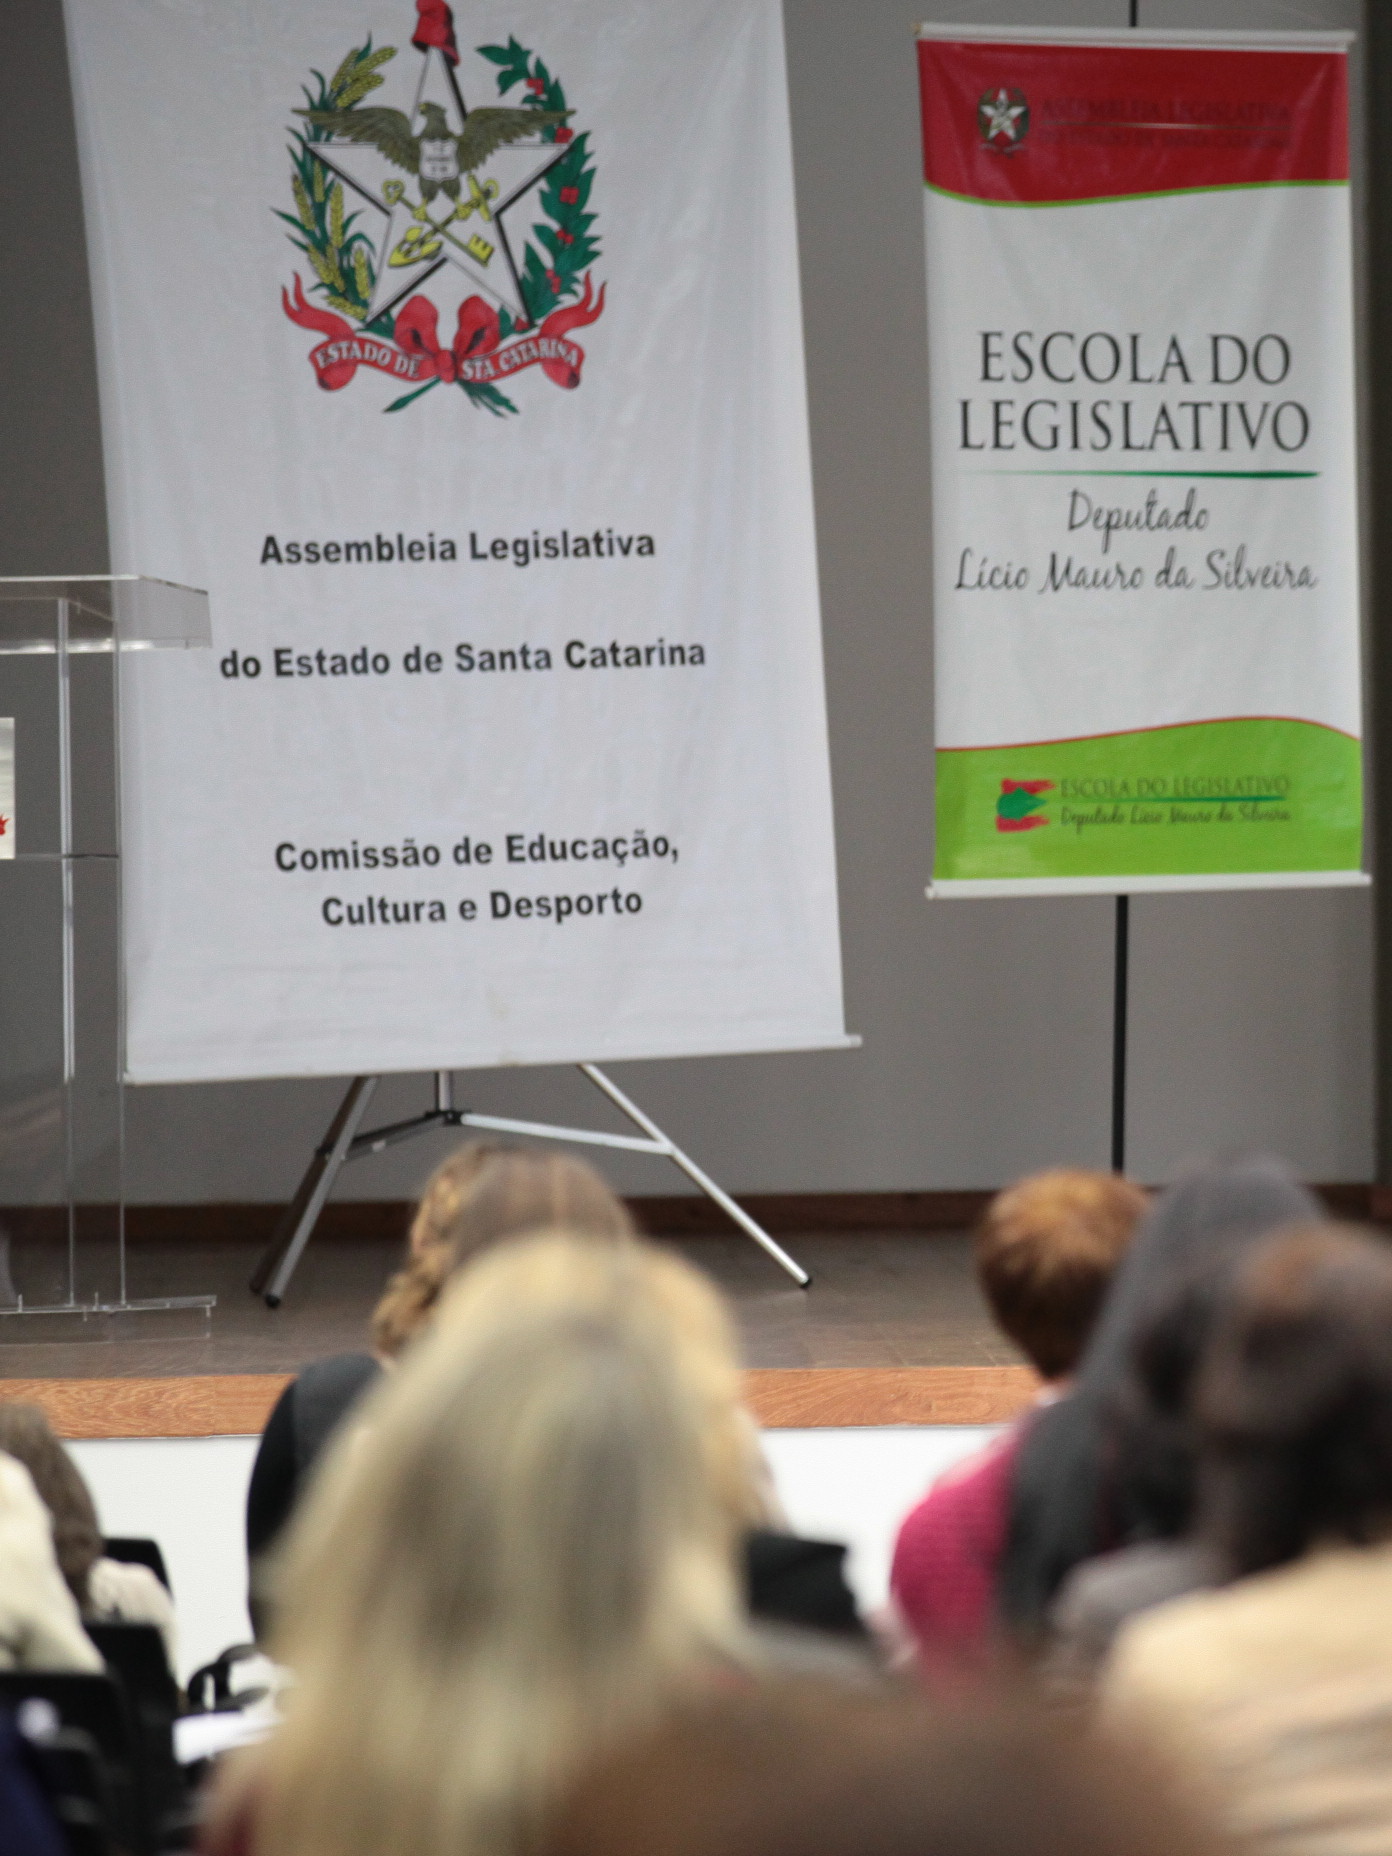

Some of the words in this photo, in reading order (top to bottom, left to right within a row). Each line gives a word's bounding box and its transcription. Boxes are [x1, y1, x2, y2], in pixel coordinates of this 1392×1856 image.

[316, 341, 391, 369] ESTADO
[394, 356, 420, 378] DE
[499, 337, 579, 372] CATARINA
[978, 331, 1194, 385] ESCOLA
[1210, 333, 1291, 385] DO
[957, 398, 1310, 452] LEGISLATIVO
[1067, 488, 1209, 553] Deputado
[260, 532, 457, 565] Assembleia
[469, 530, 656, 567] Legislativa
[954, 548, 1028, 592] Lício
[1036, 552, 1145, 594] Mauro
[1154, 547, 1195, 589] da
[1200, 545, 1319, 590] Silveira
[220, 648, 261, 679] do
[274, 645, 391, 677] Estado
[402, 644, 443, 674] de
[455, 643, 552, 674] Santa
[564, 638, 706, 670] Catarina
[1060, 777, 1130, 798] ESCOLA
[1136, 777, 1168, 797] DO
[1173, 775, 1290, 796] LEGISLATIVO
[274, 837, 441, 873] Comissão
[451, 837, 494, 867] de
[505, 831, 680, 870] Educação,
[321, 893, 447, 927] Cultura
[458, 898, 478, 922] e
[489, 888, 643, 926] Desporto
